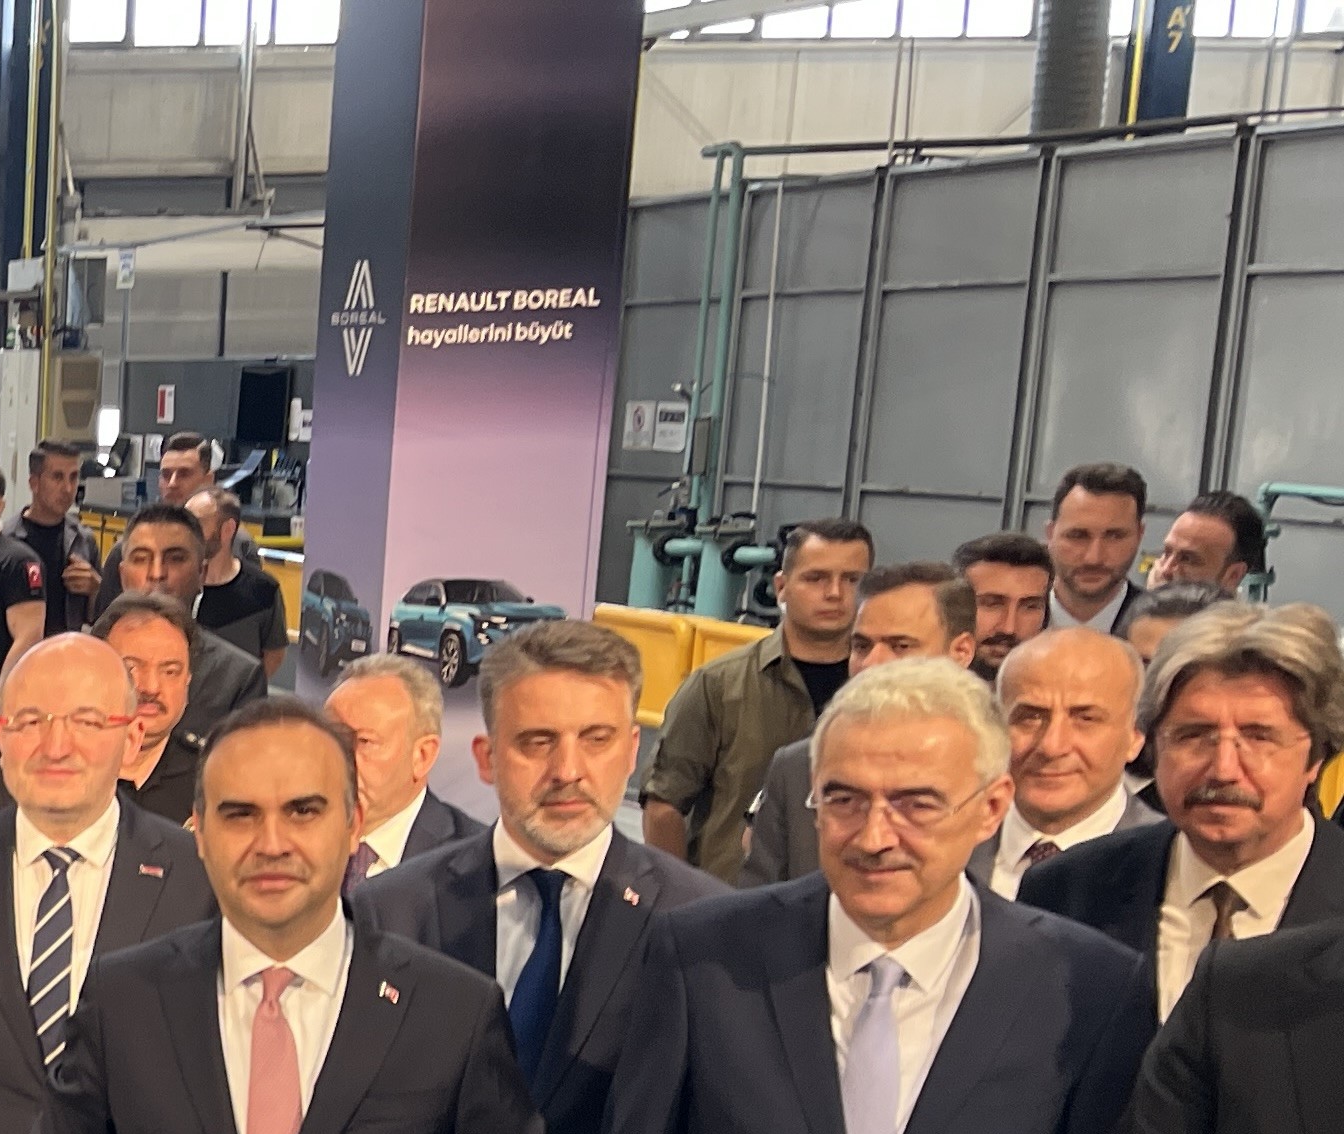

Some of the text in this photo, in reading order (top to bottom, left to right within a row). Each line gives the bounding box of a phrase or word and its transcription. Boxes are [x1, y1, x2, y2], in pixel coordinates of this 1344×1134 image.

[1167, 31, 1183, 53] 7
[409, 286, 601, 314] RENAULT BOREAL
[331, 311, 386, 326] BOREAL
[407, 320, 573, 349] hayallerini büyüt
